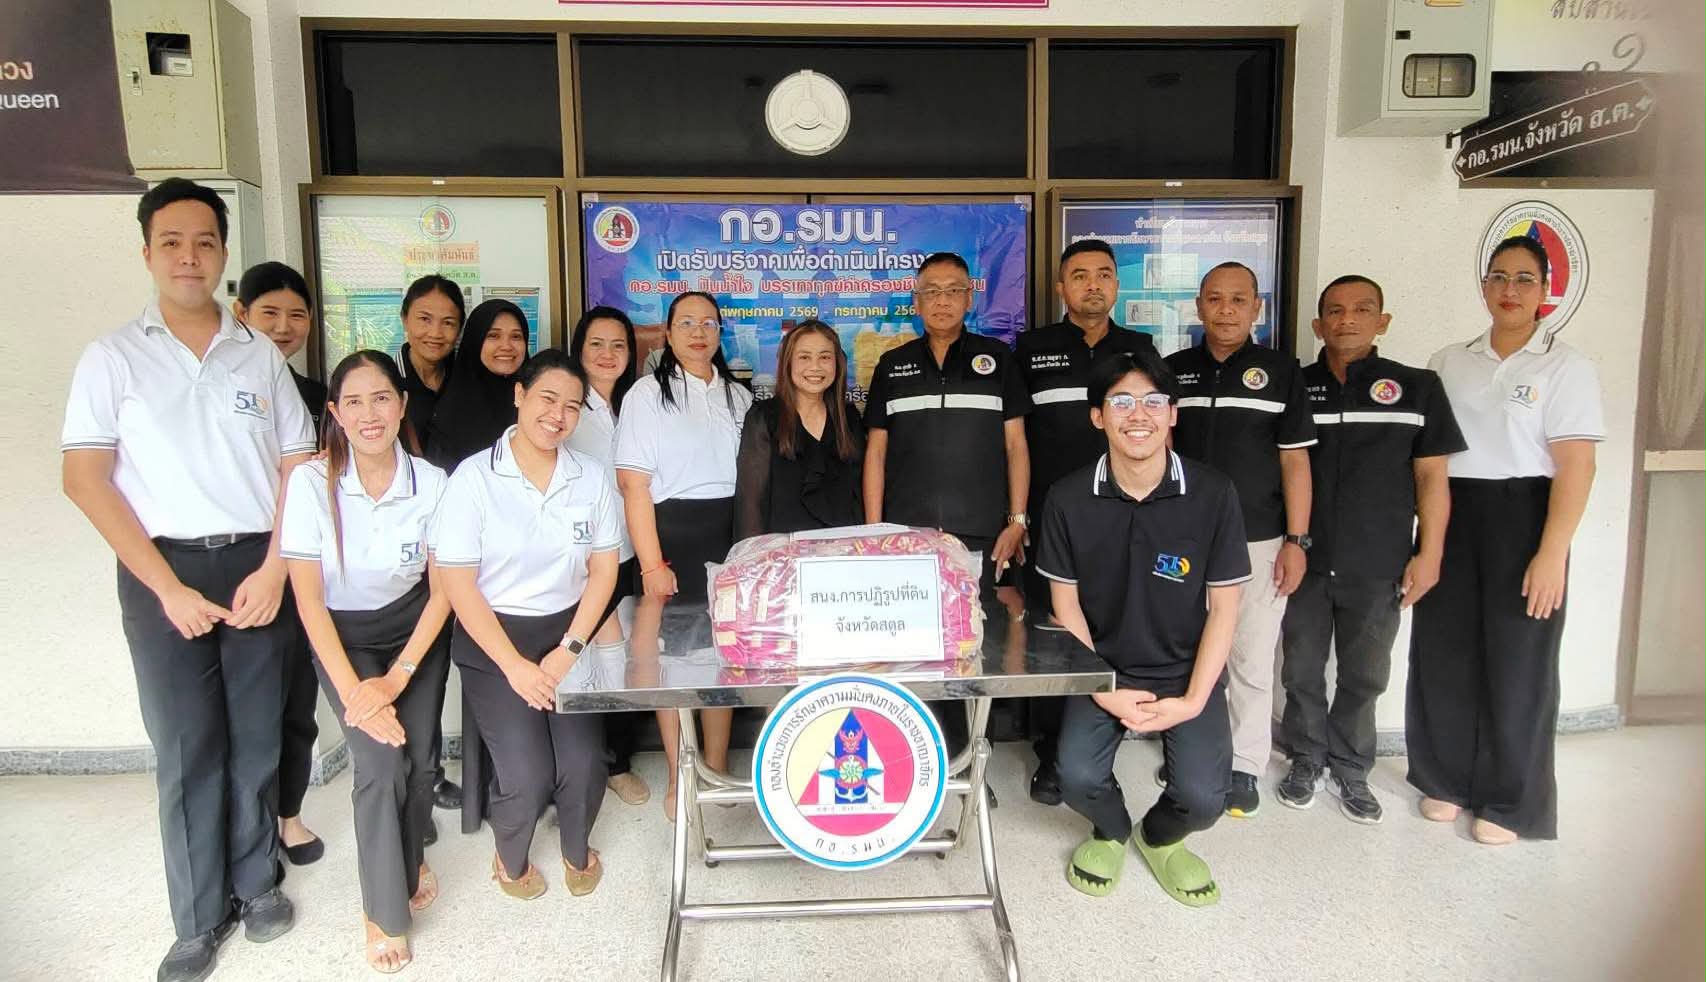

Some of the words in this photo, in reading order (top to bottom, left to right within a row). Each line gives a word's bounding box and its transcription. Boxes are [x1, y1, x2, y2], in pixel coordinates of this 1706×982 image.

[0, 61, 34, 80] วง
[0, 93, 60, 109] ueen
[719, 208, 898, 244] กอ.รมน.
[657, 246, 928, 271] เปิดรับบริจาคเพื่อดำเนินโครง
[719, 305, 784, 320] ต่พฤษภาคม
[789, 306, 819, 318] 2569
[894, 306, 918, 317] 256
[810, 580, 929, 607] สนง.การปฏิรูปที่ดิน
[835, 615, 906, 637] จังหวัดสตูล
